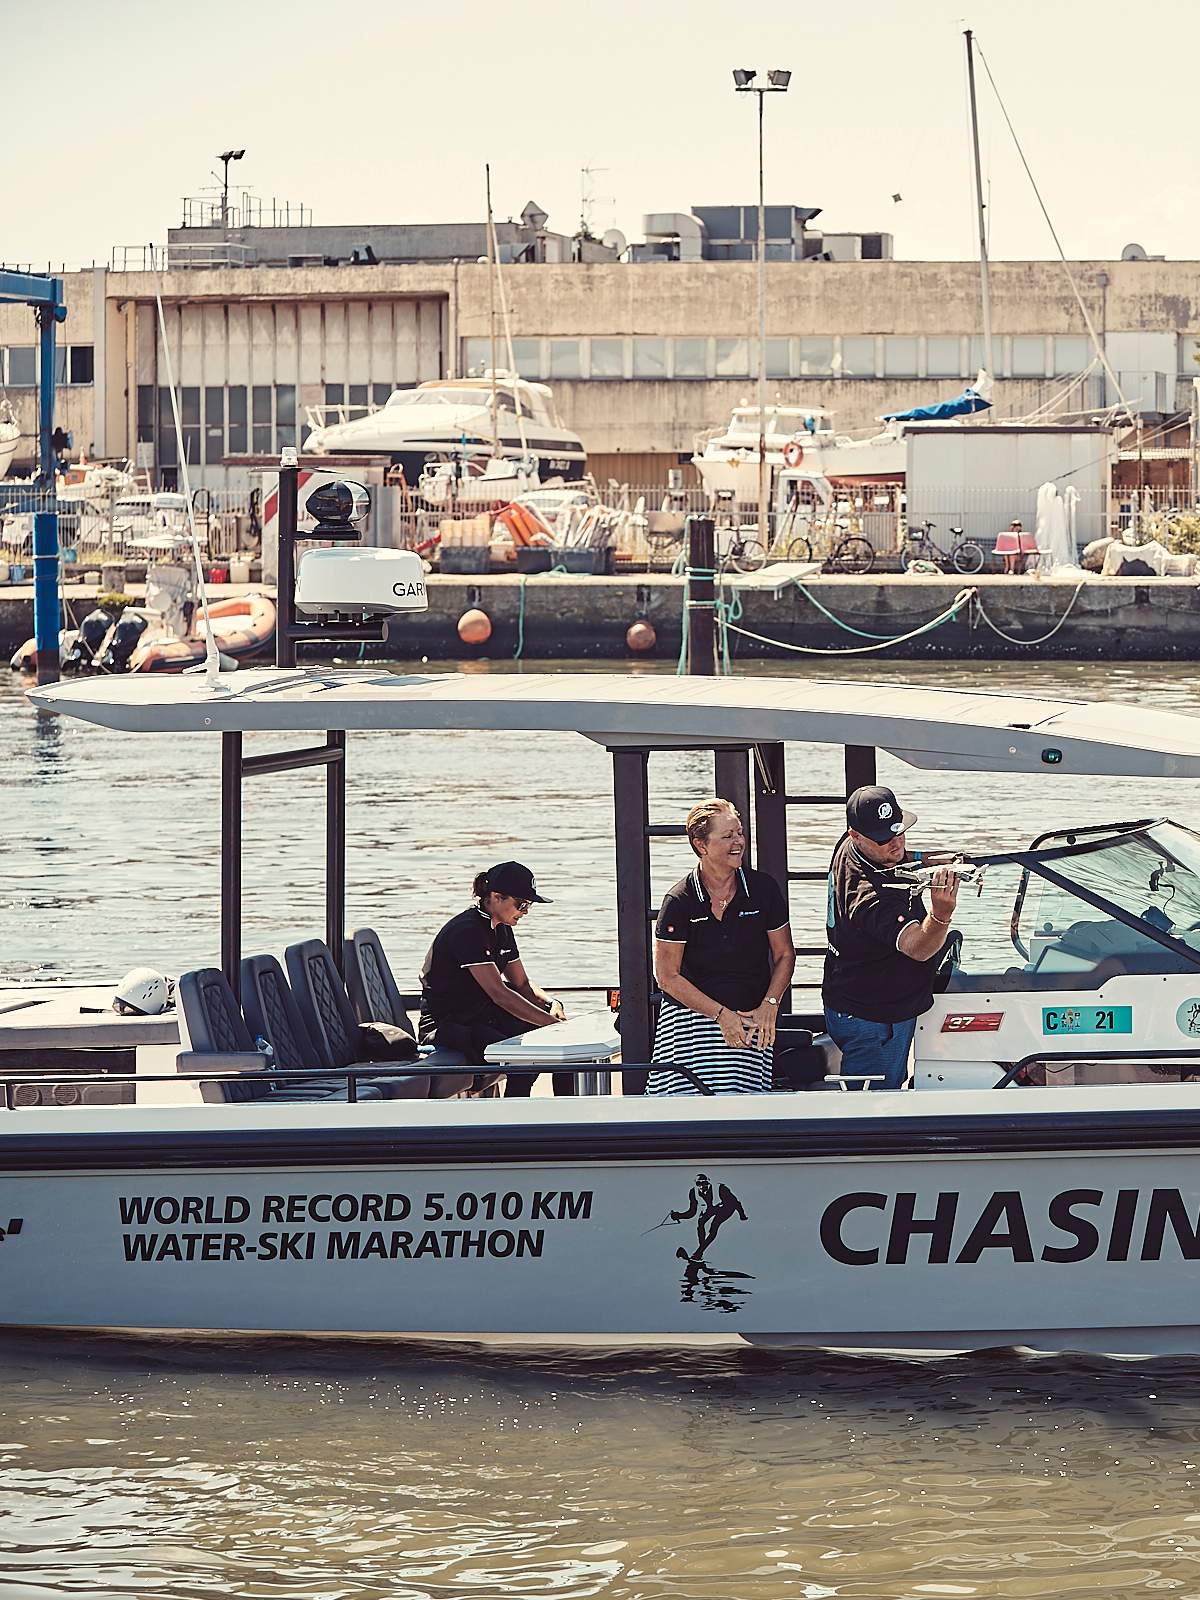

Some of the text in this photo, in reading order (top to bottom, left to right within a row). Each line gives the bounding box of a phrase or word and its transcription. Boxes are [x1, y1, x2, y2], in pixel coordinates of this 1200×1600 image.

[392, 582, 427, 597] GAR
[948, 1016, 976, 1029] 37
[1095, 1011, 1114, 1030] 21
[118, 1190, 594, 1225] WORLD RECORD 5.010 KM
[123, 1229, 545, 1262] WATER-SKI MARATHON
